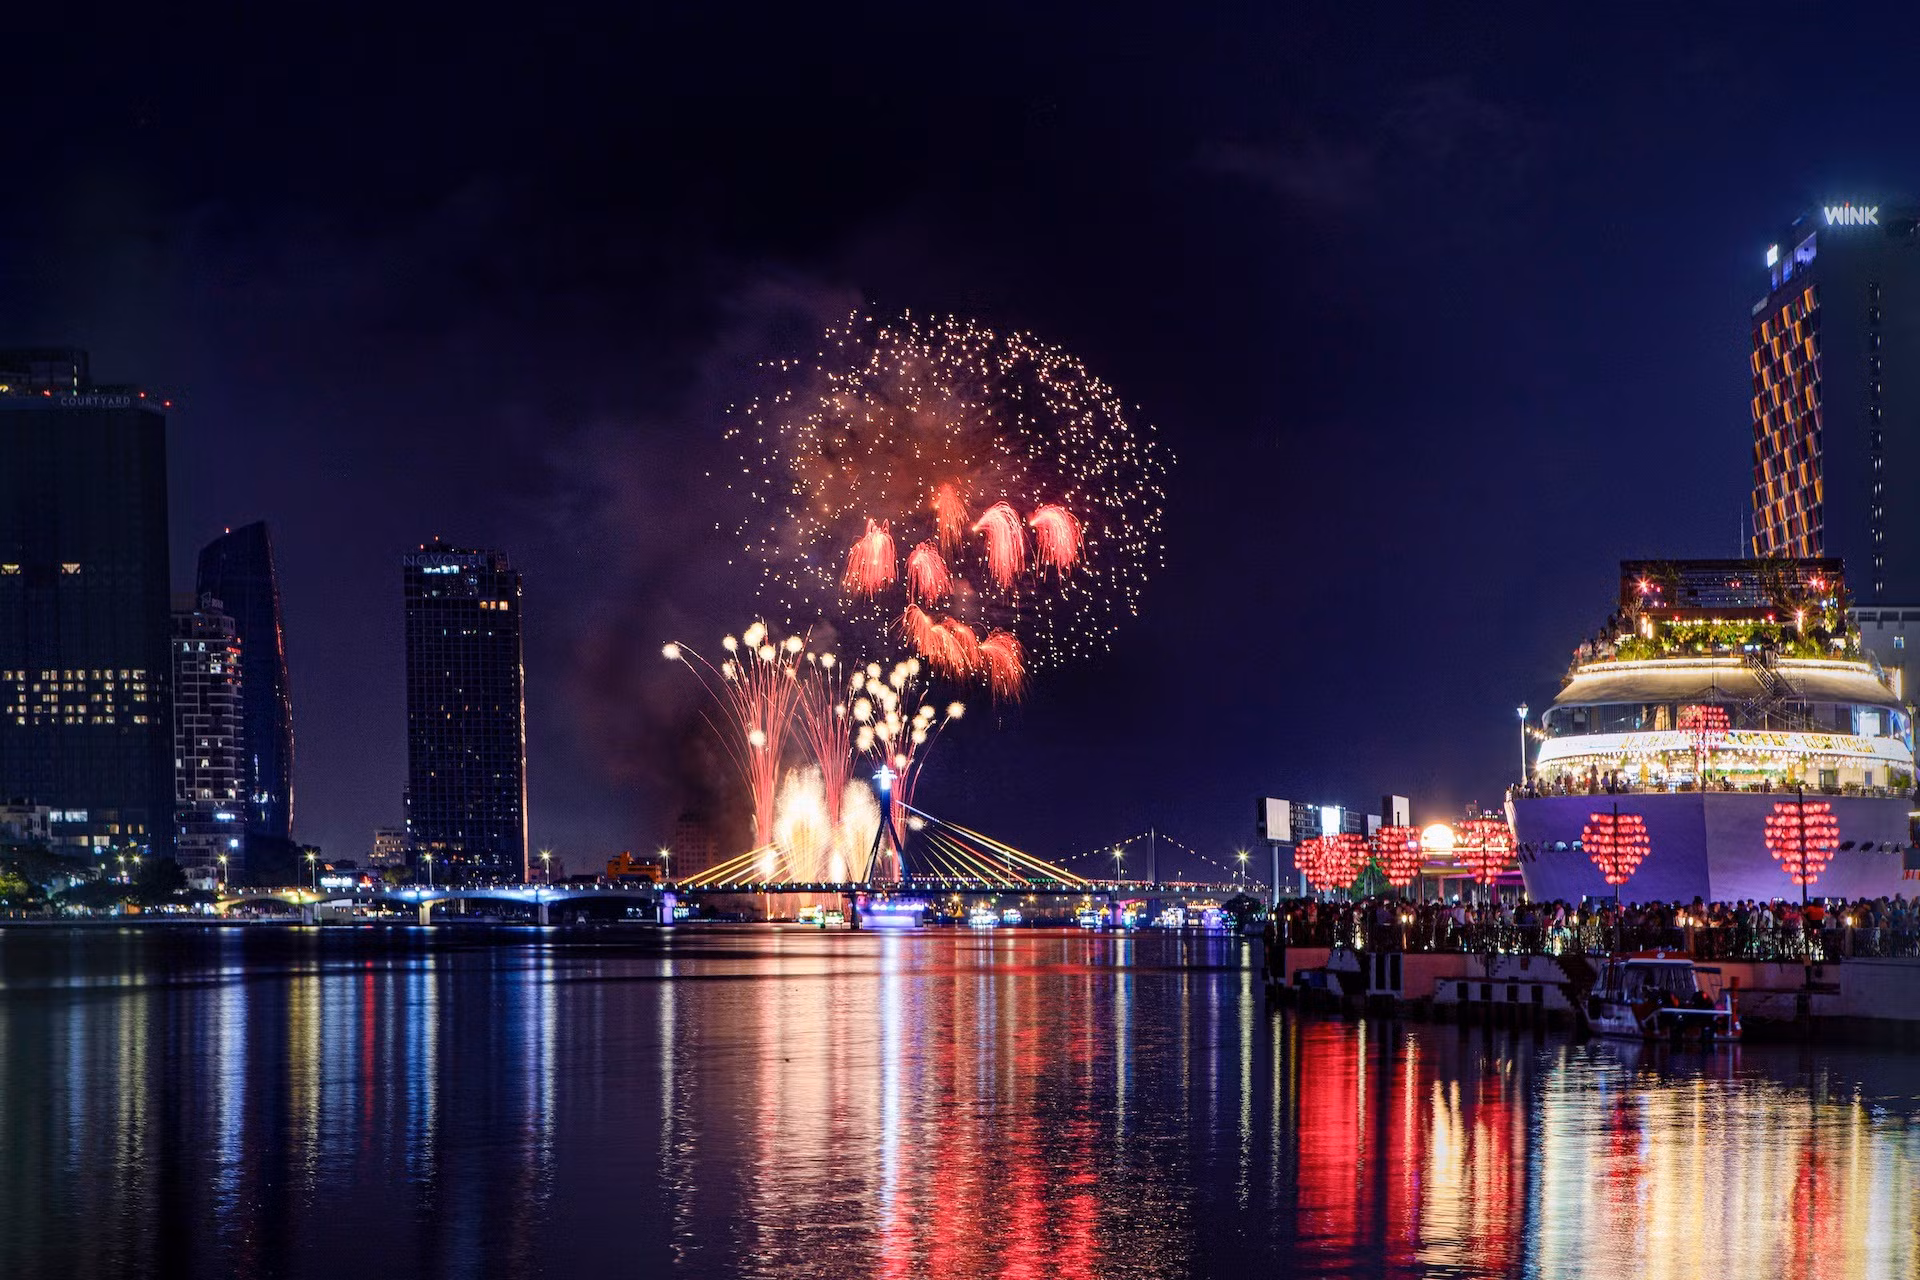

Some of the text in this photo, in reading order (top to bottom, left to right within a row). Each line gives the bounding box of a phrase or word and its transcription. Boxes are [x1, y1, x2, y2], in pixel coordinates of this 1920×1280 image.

[1824, 205, 1879, 226] WINK
[60, 396, 131, 407] COURTYARD
[403, 554, 487, 567] NOVOTEL
